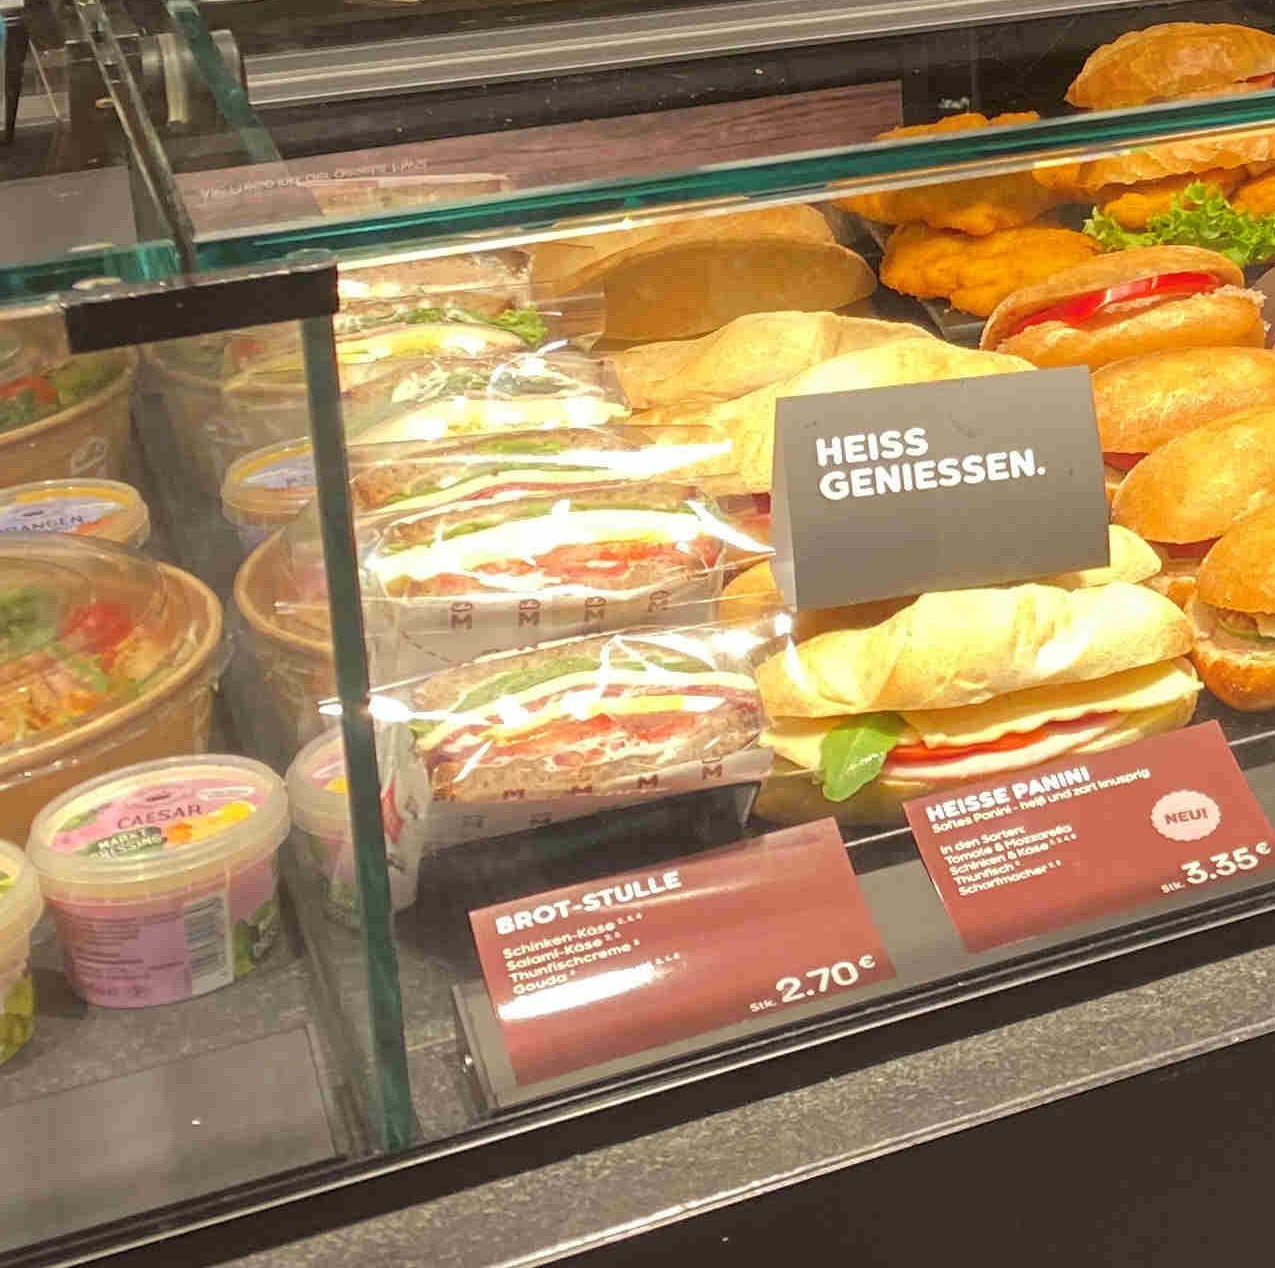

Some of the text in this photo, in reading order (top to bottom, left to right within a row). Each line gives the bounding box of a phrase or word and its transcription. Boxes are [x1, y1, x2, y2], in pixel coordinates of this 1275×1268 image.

[815, 427, 929, 467] HEISS
[818, 448, 1047, 501] GENIESSEN.
[925, 765, 1092, 824] HEISSE PANINI
[973, 804, 1012, 823] Panini
[1046, 788, 1073, 804] und
[1073, 781, 1099, 798] zart
[117, 804, 203, 830] CAESAR
[1163, 806, 1208, 827] NEU!
[940, 824, 1026, 856] In den Sorten:
[944, 823, 1073, 865] Tomate & Mozzarella
[949, 853, 1007, 878] Schinken
[1006, 848, 1018, 862] &
[954, 862, 1014, 887] Thunfisch
[958, 864, 1049, 898] Scharfmacher
[1160, 840, 1272, 895] Stk. 3.35€
[494, 869, 684, 936] BROT-STULLE
[510, 942, 633, 983] Thunfischcreme
[513, 972, 569, 996] Gouda
[749, 953, 877, 1014] Stk. 2.70€
